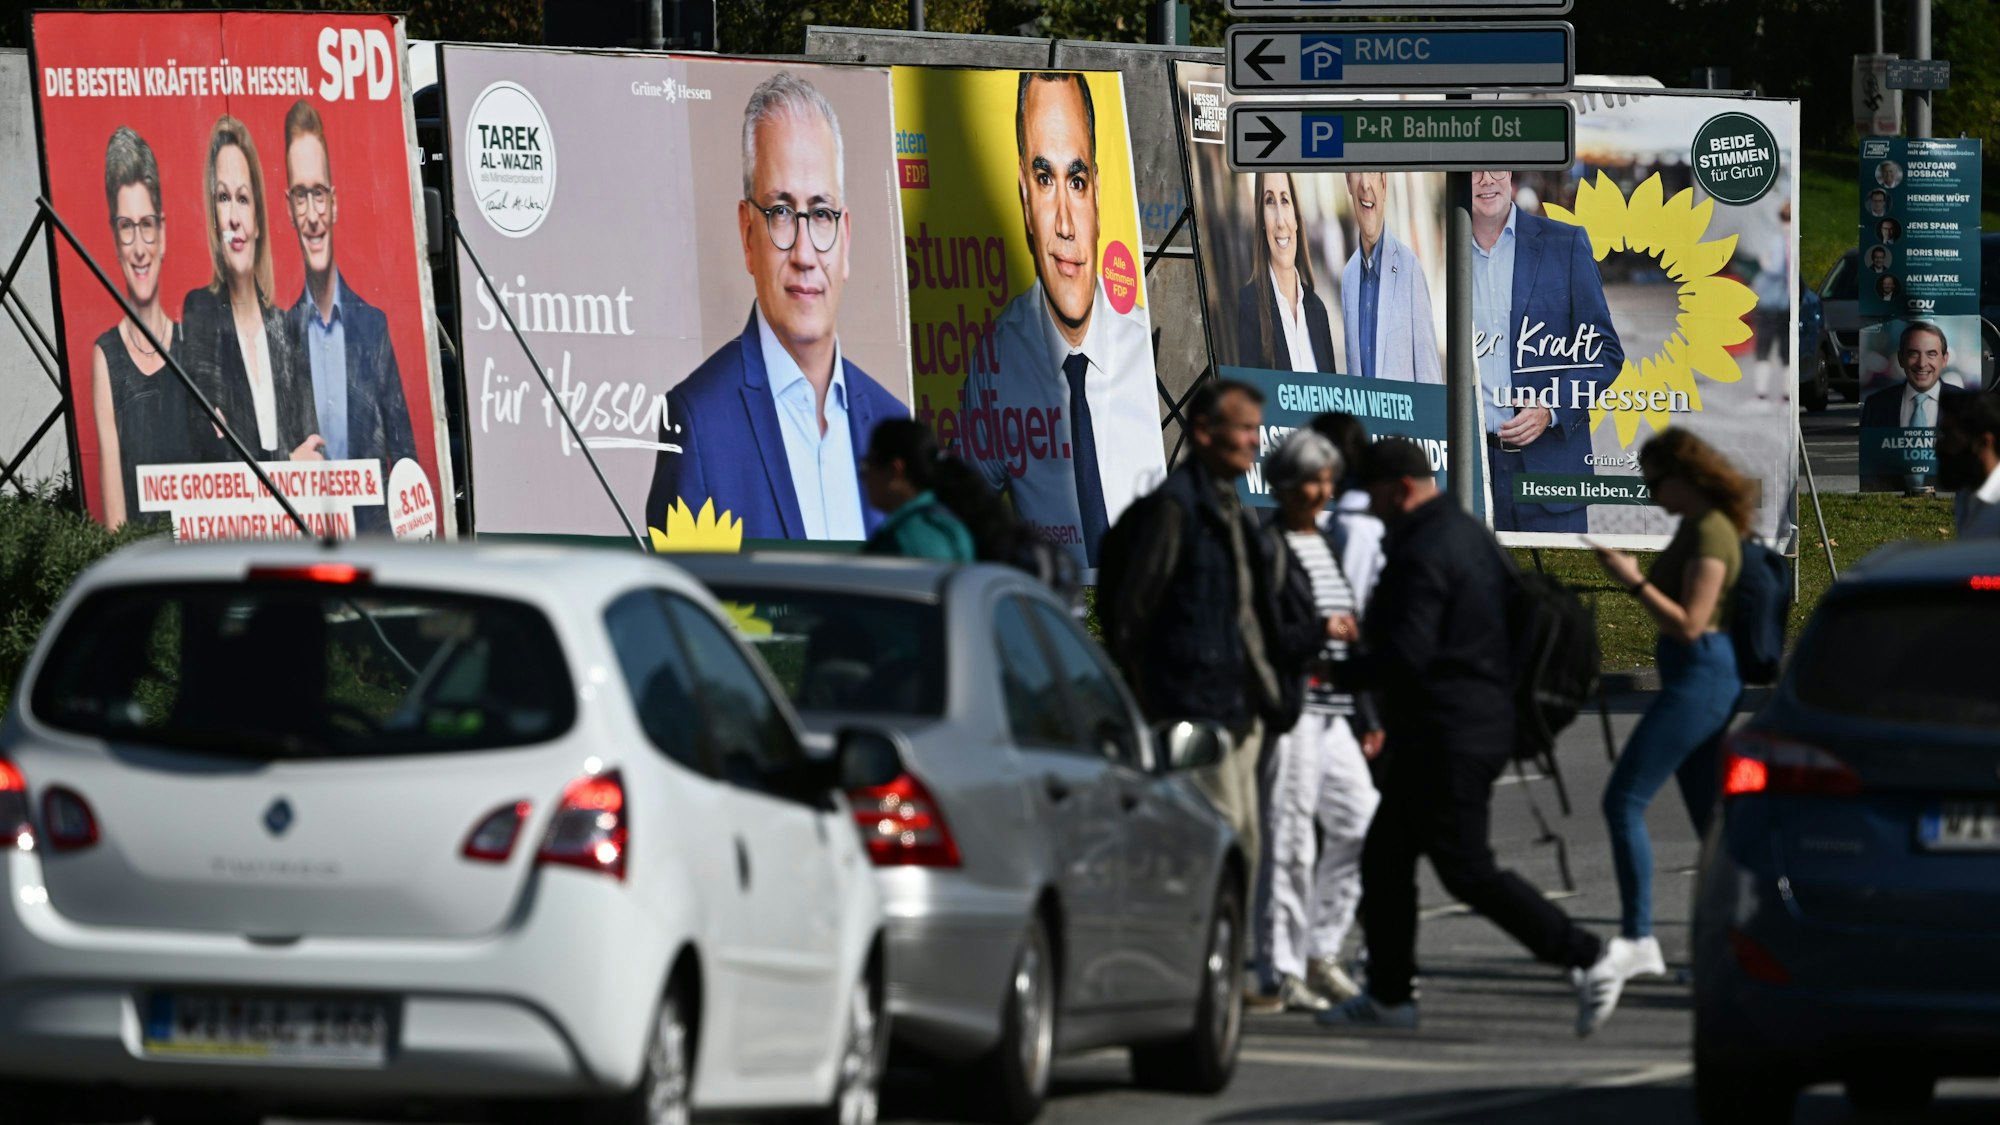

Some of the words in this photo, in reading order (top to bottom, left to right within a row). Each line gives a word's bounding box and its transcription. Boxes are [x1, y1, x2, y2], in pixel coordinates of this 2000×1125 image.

[1355, 38, 1431, 60] RMCC
[317, 27, 394, 102] SPD
[44, 67, 73, 97] DIE
[77, 67, 141, 97] BESTEN
[143, 59, 209, 96] KRÄFTE
[210, 58, 245, 96] FÜR
[247, 66, 314, 96] HESSEN.
[631, 80, 662, 97] Grüne
[677, 84, 712, 100] Hessen
[1193, 92, 1219, 107] HESSEN
[1201, 105, 1227, 121] WEITER
[1356, 116, 1392, 138] P+R
[1403, 116, 1481, 138] Bahnhof
[1491, 116, 1522, 138] Ost
[478, 125, 541, 151] TAREK
[1710, 134, 1755, 151] BEIDE
[481, 152, 543, 171] AL-WAZIR
[1700, 147, 1769, 168] STIMMEN
[1907, 162, 1957, 170] WOLFGANG
[905, 164, 927, 183] FDP
[1711, 169, 1728, 182] für
[1730, 165, 1763, 180] Grün
[1907, 170, 1950, 178] BOSBACH
[1907, 195, 1944, 203] HENDRIK
[1946, 193, 1971, 203] WÜST
[1907, 222, 1928, 230] JENS
[1930, 222, 1958, 230] SPAHN
[1113, 255, 1126, 270] Alle
[1906, 249, 1932, 257] BORIS
[1934, 249, 1959, 257] RHEIN
[904, 222, 1009, 308] stung
[1105, 266, 1135, 287] Stimmen
[1924, 275, 1959, 283] WATZKE
[1113, 283, 1128, 298] FDP
[476, 274, 636, 336] Stimmt
[1908, 299, 1935, 309] CDU
[912, 303, 1000, 376] ucht
[1516, 315, 1603, 367] Kraft
[480, 356, 530, 433] für
[542, 350, 683, 457] Hessen.
[1278, 383, 1367, 416] GEMEINSAM
[1368, 390, 1414, 421] WEITER
[1493, 377, 1560, 409] und
[1569, 379, 1691, 413] Hessen
[1881, 437, 1938, 449] ALEXAN
[1584, 453, 1624, 466] Grüne
[1904, 449, 1936, 460] LORZ
[143, 475, 178, 502] INGE
[180, 472, 255, 502] GROEBEL,
[257, 471, 308, 498] NANCY
[310, 469, 362, 497] FAESER
[365, 469, 378, 495] &
[1522, 481, 1577, 497] Hessen
[1580, 482, 1634, 498] lieben.
[400, 482, 431, 516] 8.10.
[179, 514, 267, 543] ALEXANDER
